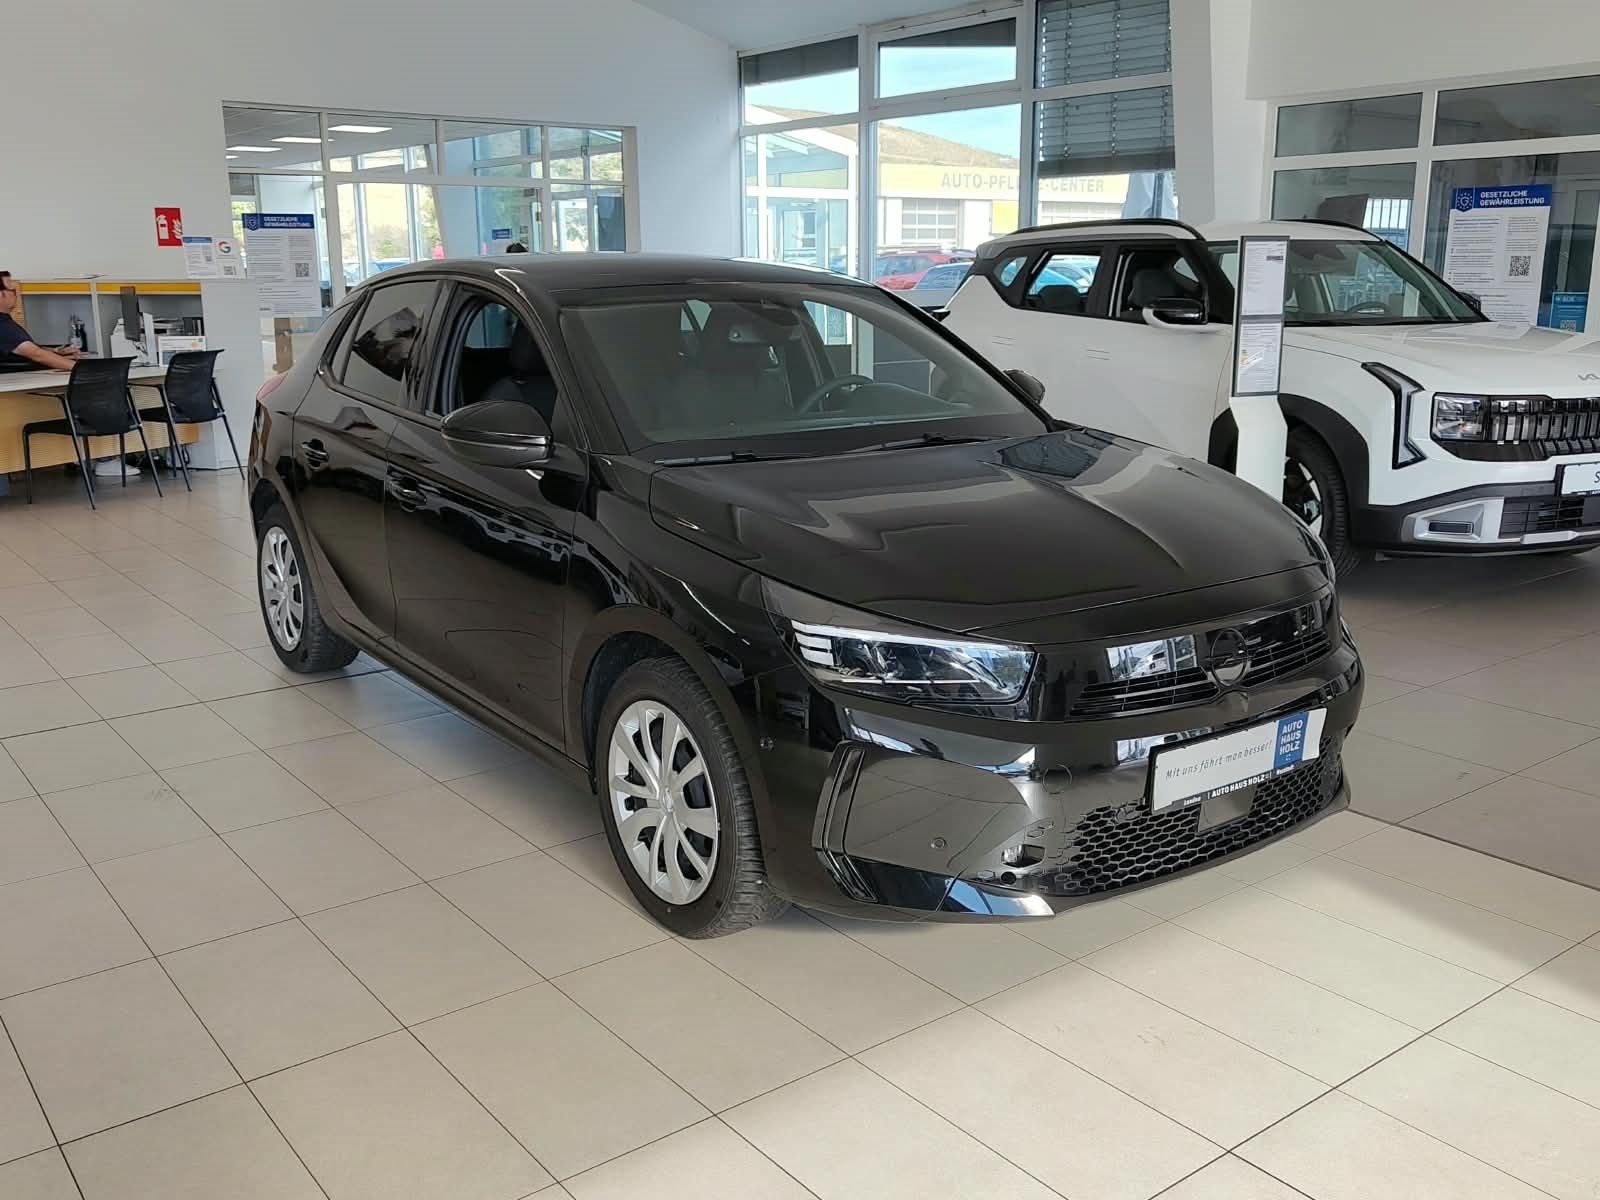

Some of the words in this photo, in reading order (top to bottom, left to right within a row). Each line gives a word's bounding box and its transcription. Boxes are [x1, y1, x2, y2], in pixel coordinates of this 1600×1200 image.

[942, 173, 1104, 193] AUTO-PFLE-CENTER
[1480, 190, 1528, 199] GESETZLICHE
[1480, 197, 1545, 206] GEWÄHRLEISTUNG
[1282, 720, 1304, 734] AUTO
[1281, 731, 1302, 744] HAUS
[1280, 741, 1300, 755] HOLZ
[1165, 768, 1180, 780] Mit
[1182, 765, 1198, 774] uns
[1200, 756, 1223, 773] fährt
[1225, 751, 1243, 763] man
[1244, 739, 1273, 758] besser!
[1211, 787, 1230, 798] AUTO
[1230, 780, 1248, 792] HAUS
[1247, 774, 1265, 786] HOLZ
